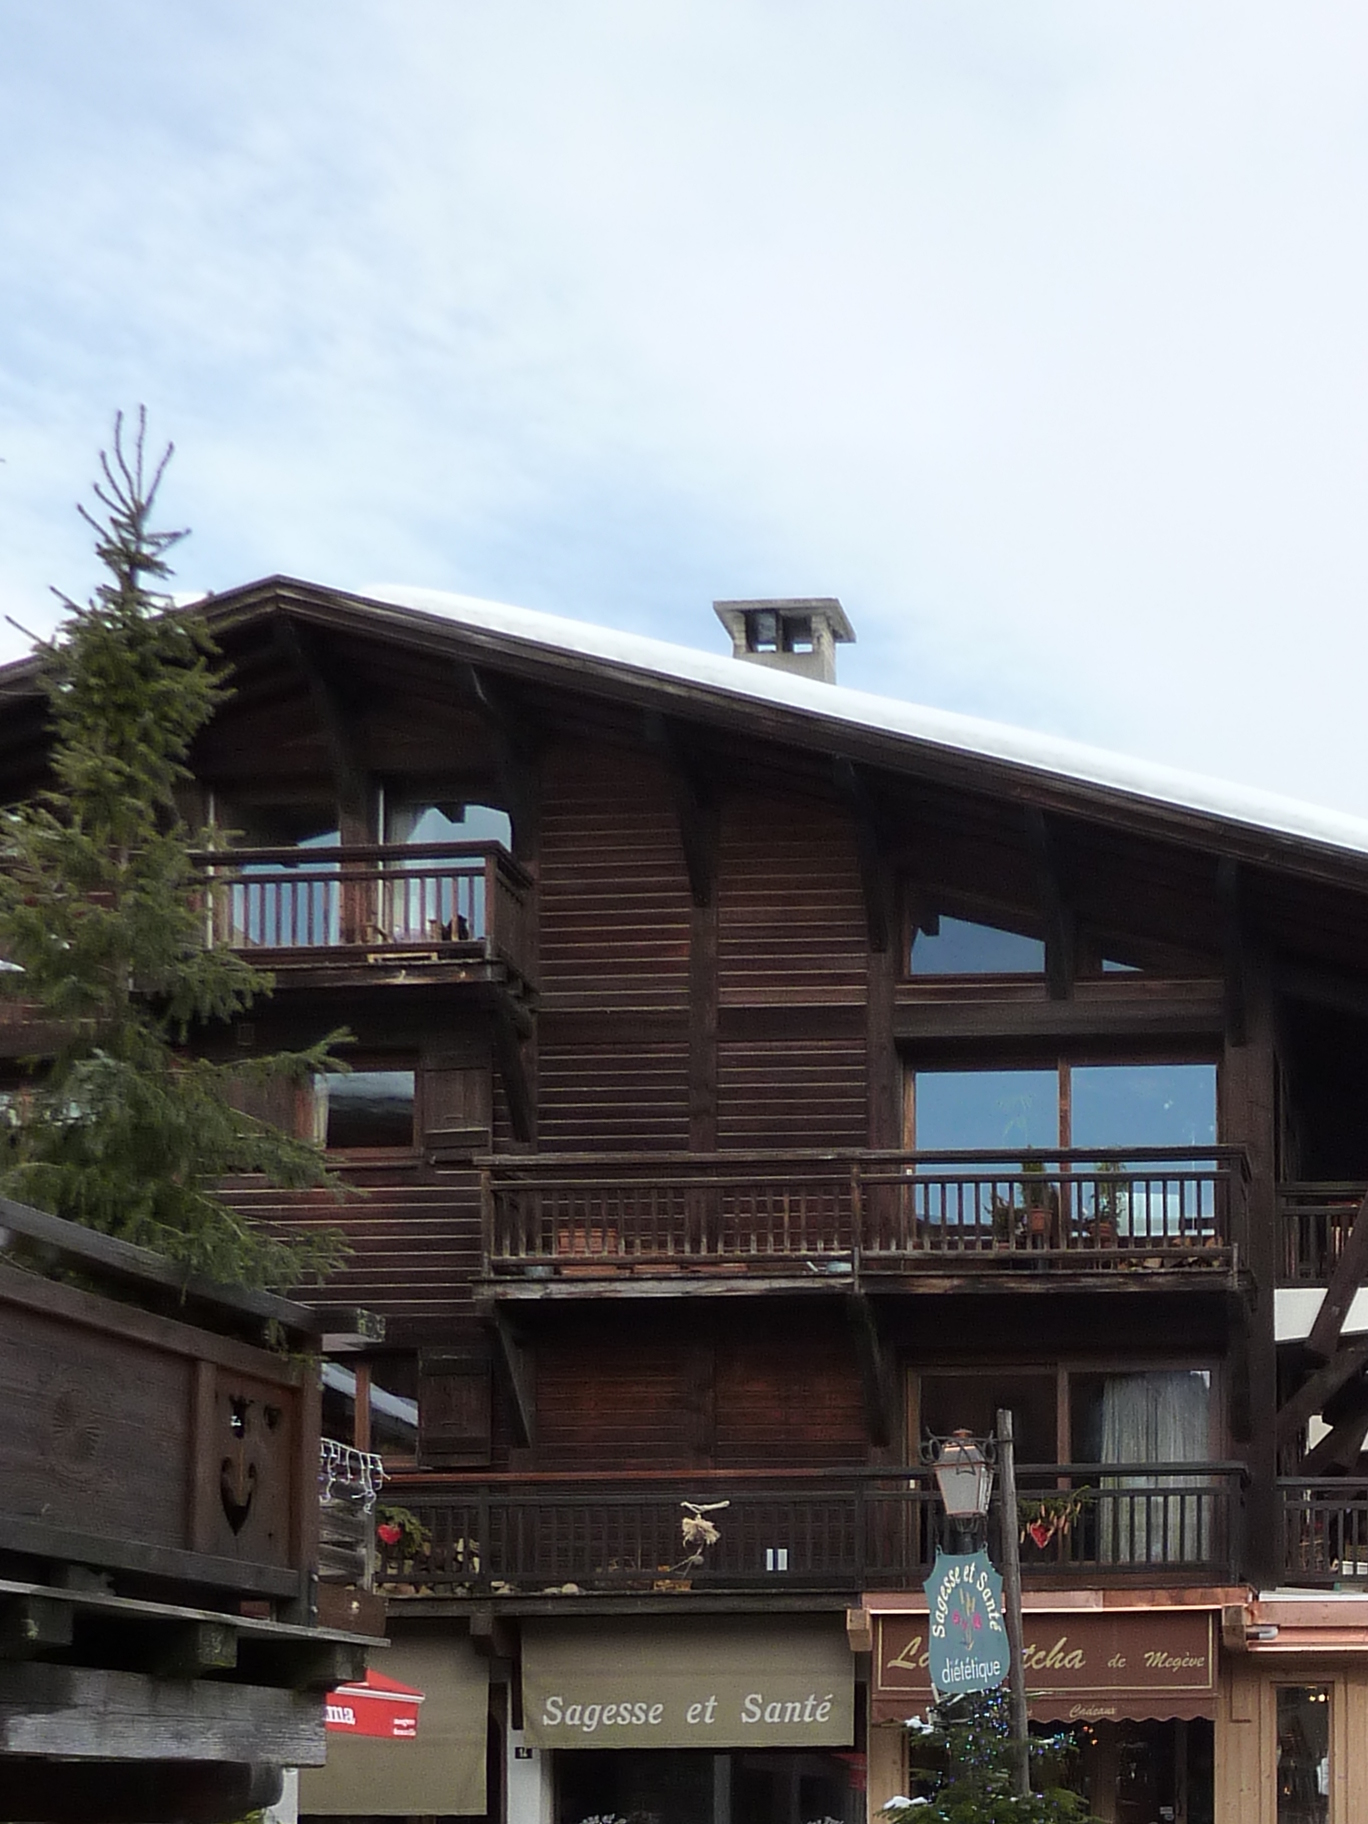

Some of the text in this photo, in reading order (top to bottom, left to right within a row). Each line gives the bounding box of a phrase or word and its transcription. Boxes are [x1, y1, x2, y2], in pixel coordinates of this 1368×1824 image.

[932, 1561, 1003, 1638] Sagesse et Santé
[941, 1656, 1001, 1683] diététique
[1023, 1636, 1087, 1670] tcha
[1107, 1652, 1127, 1668] de
[1143, 1651, 1206, 1673] Megève
[542, 1693, 834, 1732] Sagesse et Santé
